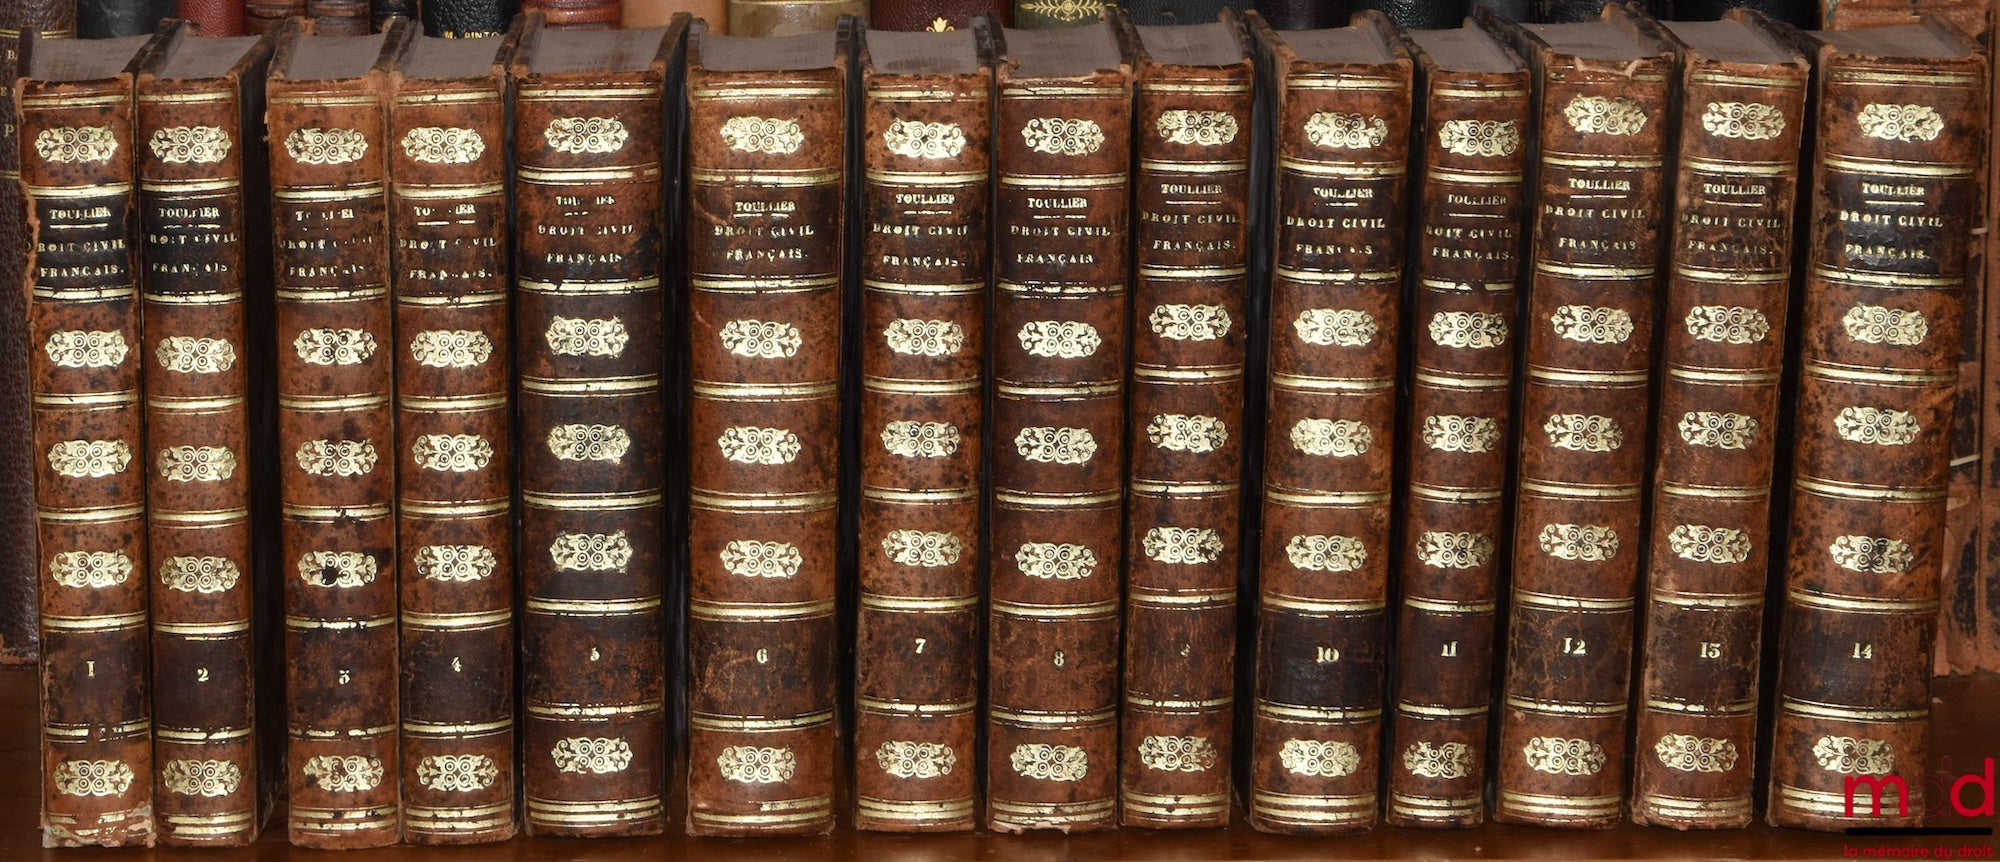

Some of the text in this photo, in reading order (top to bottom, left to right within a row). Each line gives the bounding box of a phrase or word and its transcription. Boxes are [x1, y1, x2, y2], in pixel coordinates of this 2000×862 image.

[1160, 184, 1223, 195] TOULLIER
[1568, 178, 1631, 191] TOULLIER
[1703, 183, 1766, 195] TOULLIER
[1862, 182, 1924, 196] TOULLIER
[735, 201, 796, 213] TOULLIER
[1027, 197, 1088, 209] TOULLIER
[1142, 211, 1191, 224] DROIT
[1545, 204, 1645, 219] DROIT CIVIL
[1343, 217, 1386, 229] CIVIL
[1738, 218, 1781, 229] CIVIL
[1840, 211, 1943, 228] DROIT CIVIL
[83, 239, 126, 252] CIVIL
[915, 638, 926, 654] 7
[1440, 640, 1457, 657] 11
[1563, 637, 1586, 655] 12
[1852, 641, 1873, 660] 14
[756, 648, 768, 664] 6
[1054, 651, 1065, 667] 8
[1315, 646, 1339, 663] 10
[451, 657, 461, 673] 4
[197, 668, 209, 682] 2
